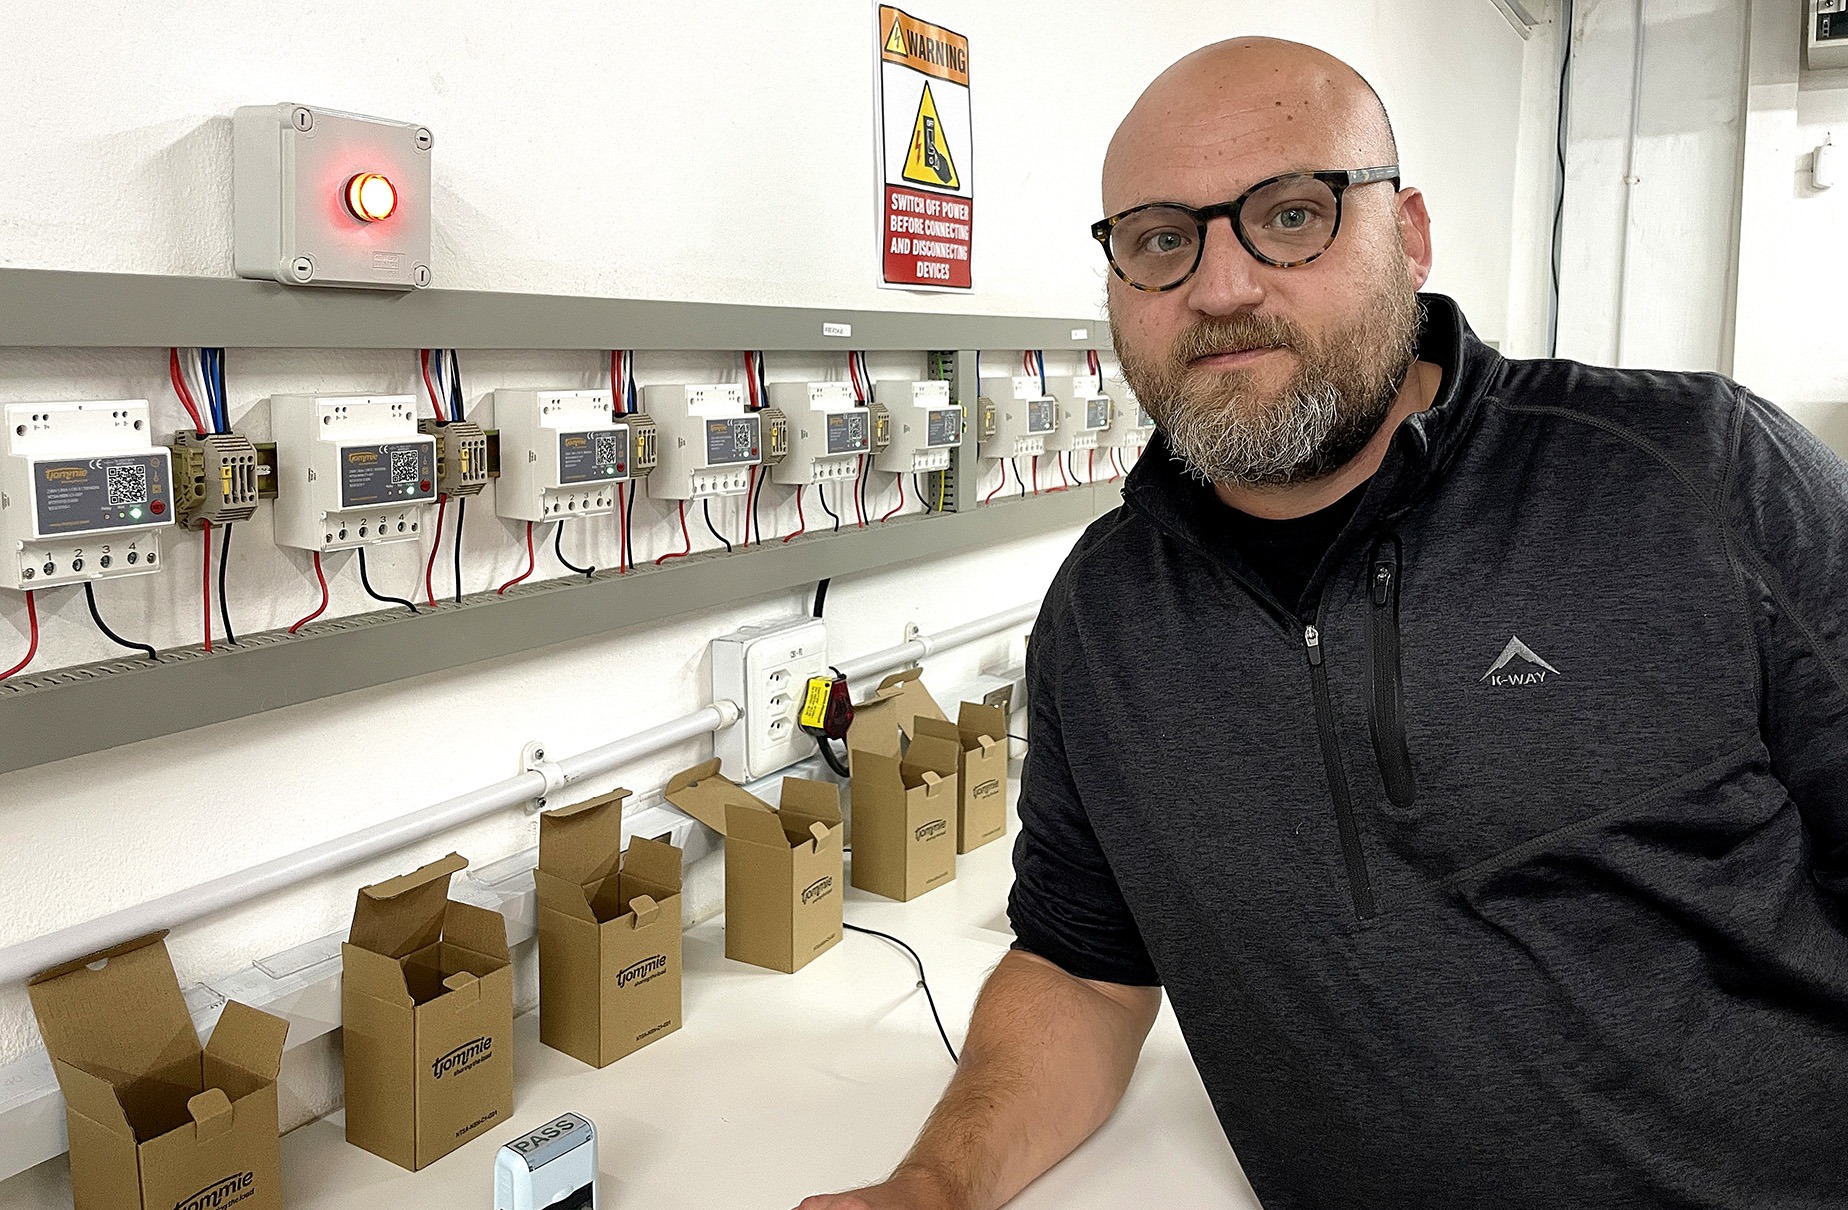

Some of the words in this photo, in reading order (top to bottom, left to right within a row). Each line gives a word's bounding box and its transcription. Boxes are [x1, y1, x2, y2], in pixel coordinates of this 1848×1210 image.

[907, 29, 966, 74] WARNING
[891, 193, 925, 213] SWITCH
[926, 199, 941, 216] OFF
[942, 202, 969, 220] POWER
[890, 215, 924, 234] BEFORE
[925, 219, 969, 240] CONNECTING
[890, 237, 911, 254] AND
[912, 239, 968, 260] DISCONNECTING
[916, 261, 950, 279] DEVICES
[89, 459, 103, 470] CE
[45, 552, 51, 560] 1
[74, 549, 83, 557] 2
[102, 545, 111, 553] 3
[128, 542, 136, 550] 4
[1491, 671, 1546, 686] K-WAY
[616, 954, 666, 988] tjommie
[432, 1036, 492, 1079] tjommie
[514, 1120, 574, 1152] PASS
[173, 1172, 254, 1210] ommie
